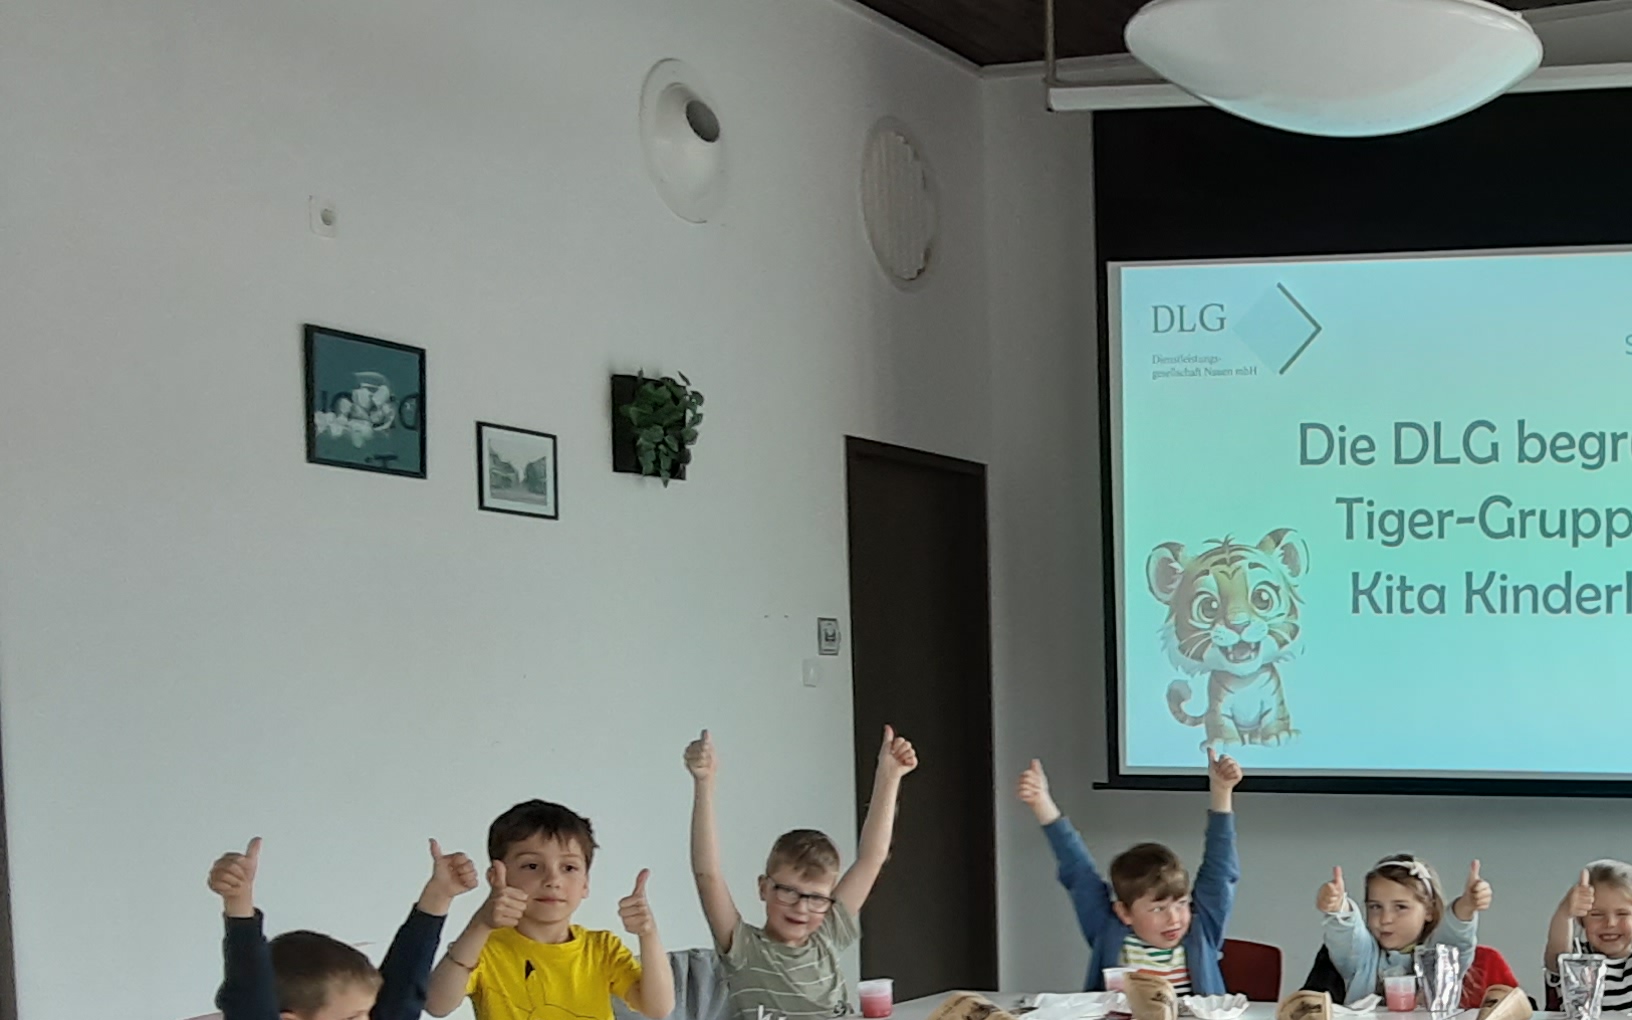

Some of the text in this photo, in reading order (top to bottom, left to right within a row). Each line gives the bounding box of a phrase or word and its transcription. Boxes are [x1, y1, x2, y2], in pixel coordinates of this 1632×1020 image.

[1151, 302, 1227, 334] DLG
[1203, 366, 1234, 378] Nauen
[1299, 422, 1376, 466] Die
[1393, 419, 1499, 466] DLG
[1350, 570, 1447, 615] Kita
